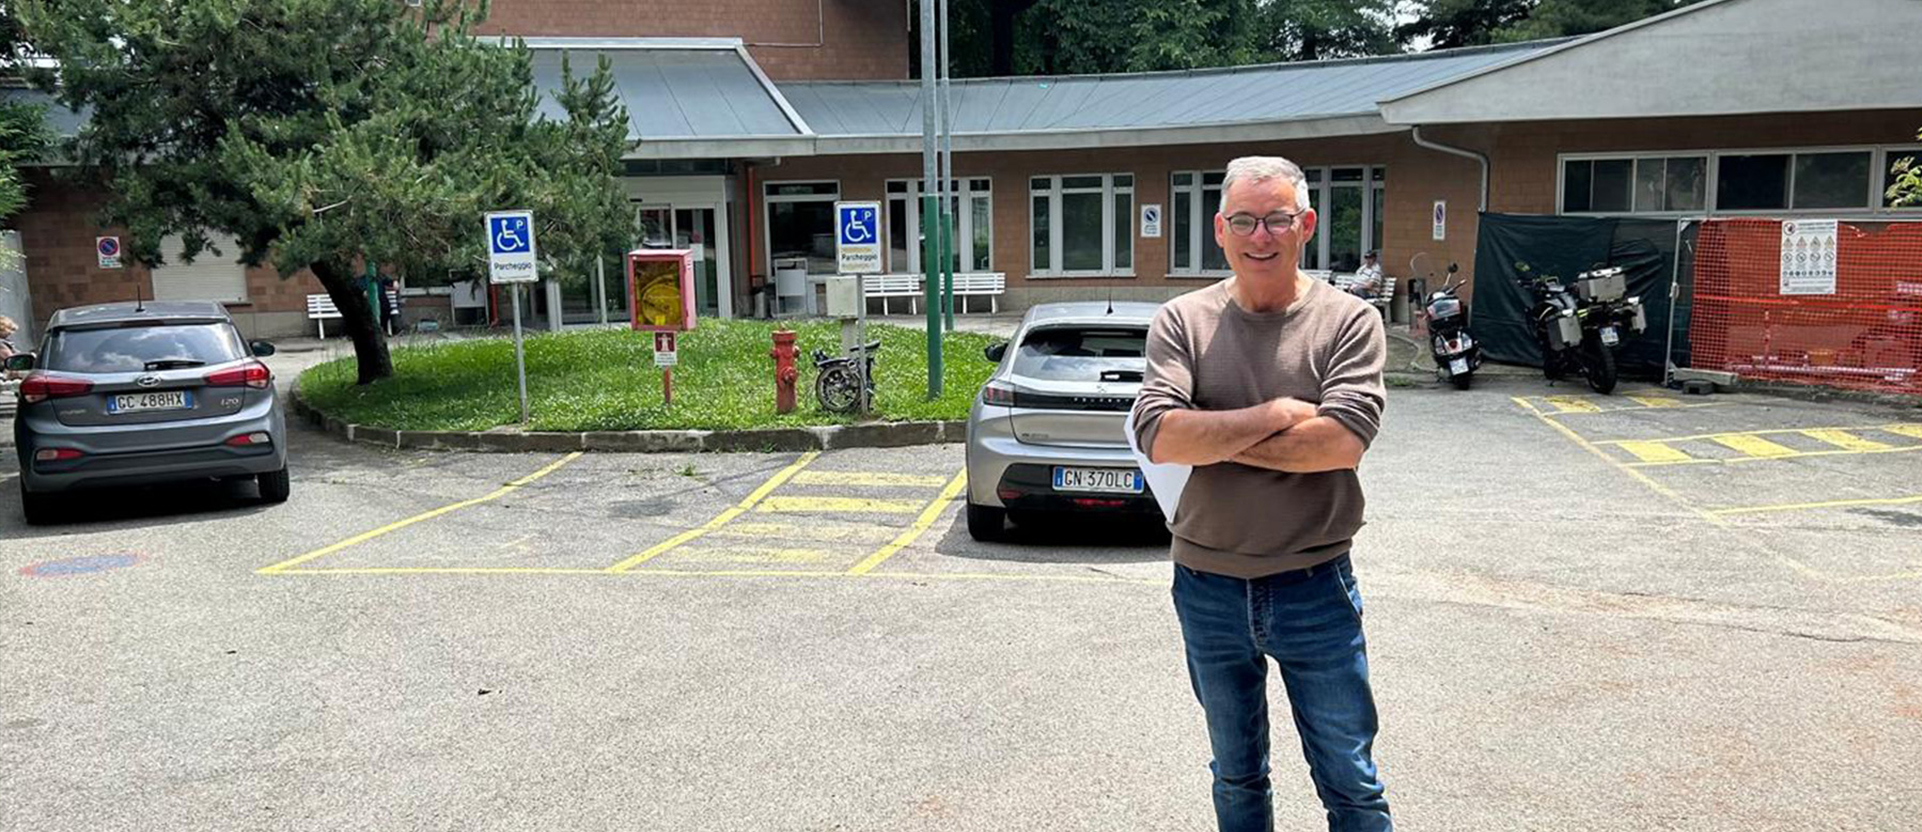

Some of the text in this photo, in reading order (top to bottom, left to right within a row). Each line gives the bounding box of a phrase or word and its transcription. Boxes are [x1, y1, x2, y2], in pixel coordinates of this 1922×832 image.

[864, 210, 873, 221] P
[516, 220, 524, 230] P
[140, 391, 183, 407] 488HX
[1064, 470, 1132, 488] GN 370LC
